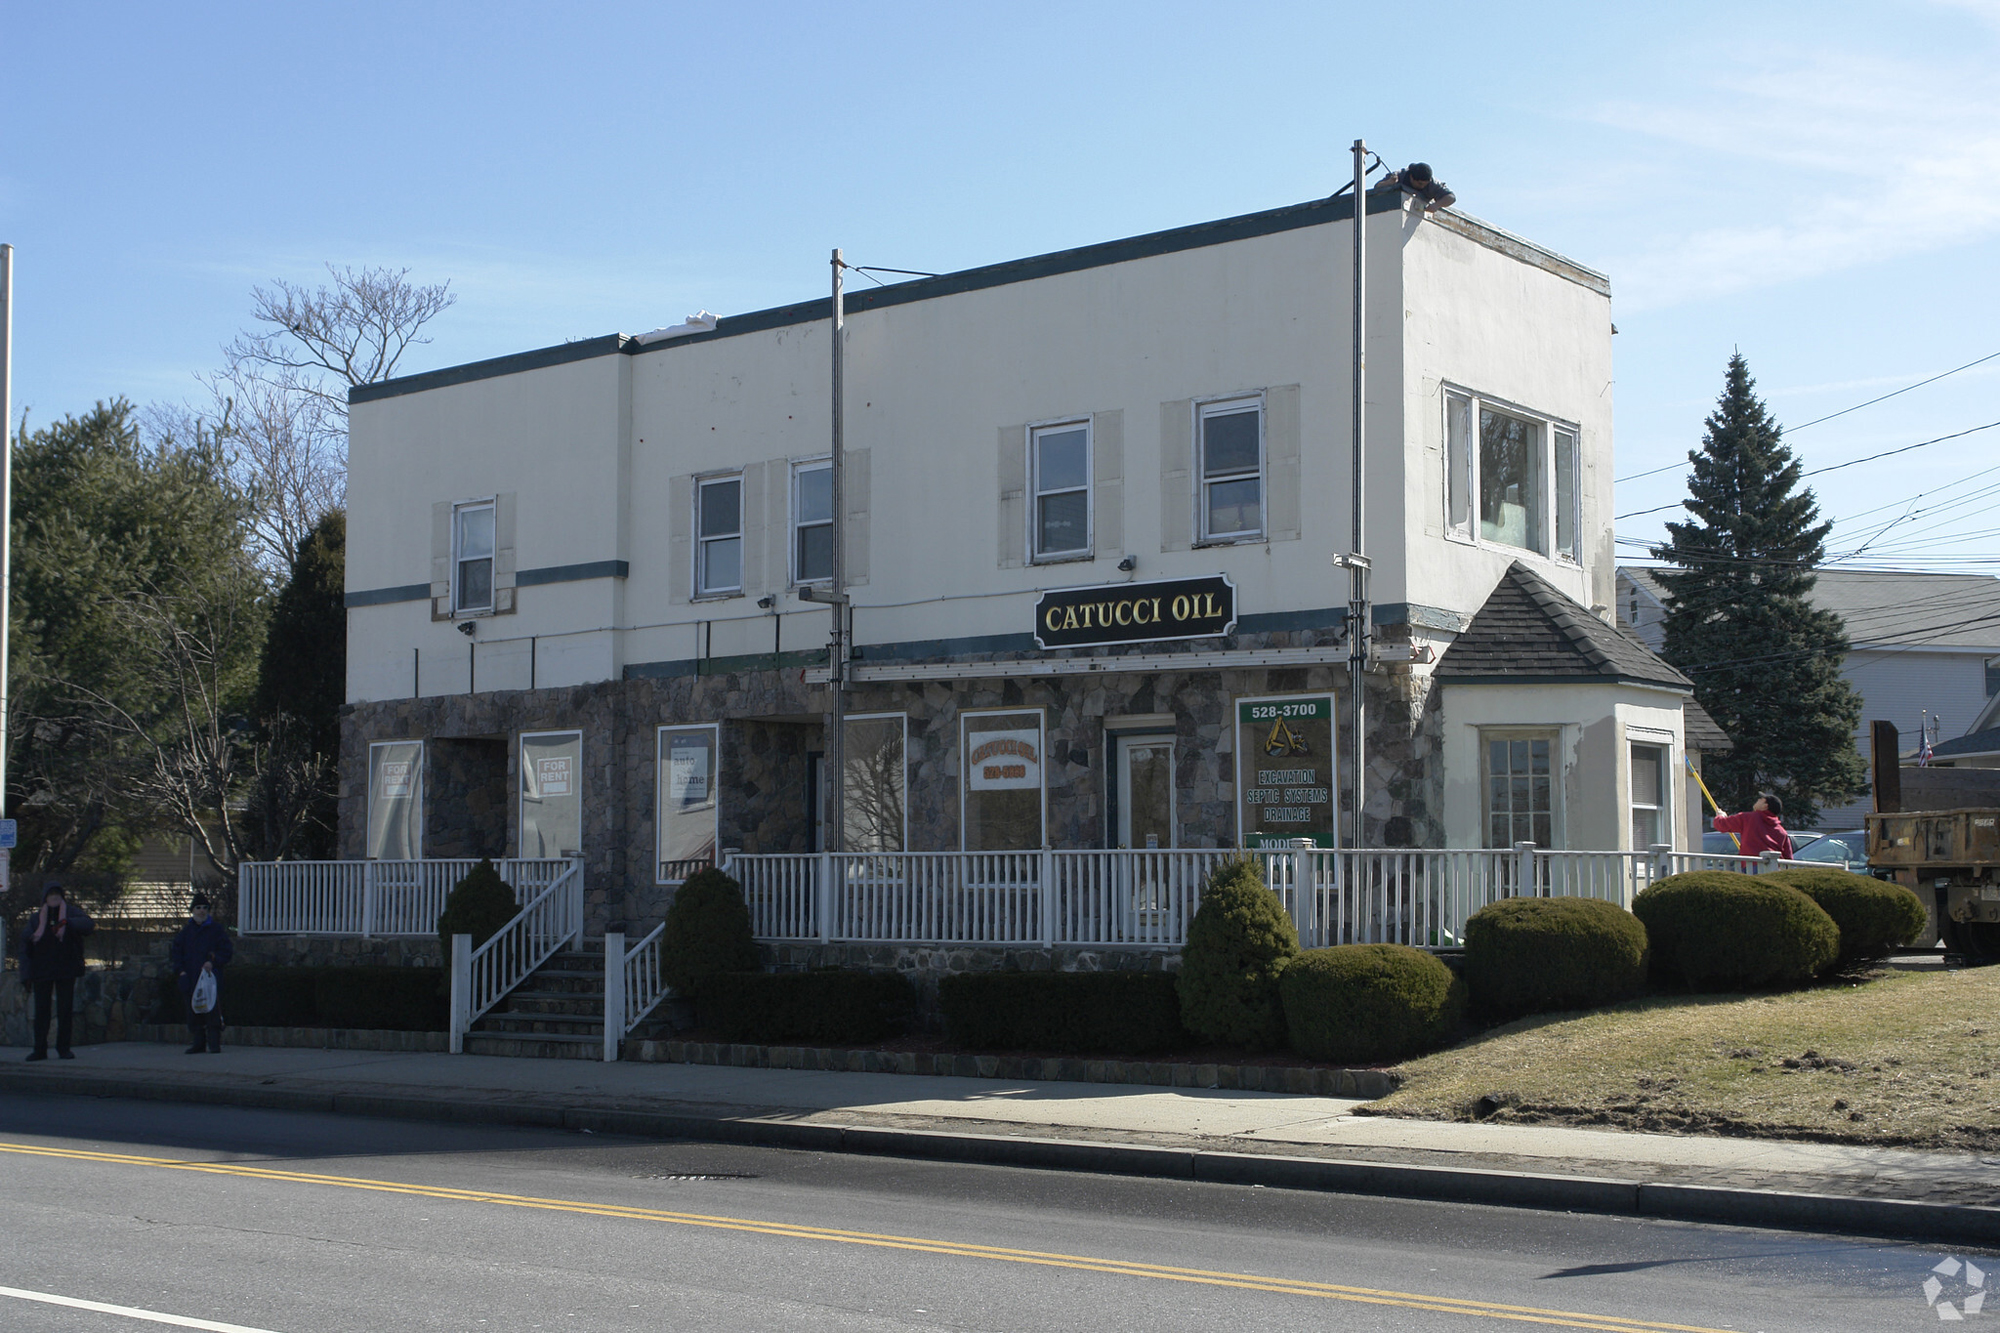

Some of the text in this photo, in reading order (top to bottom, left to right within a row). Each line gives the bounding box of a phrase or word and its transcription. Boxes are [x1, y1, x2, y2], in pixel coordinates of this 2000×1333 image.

[1046, 593, 1222, 631] CATUCCI OIL
[1252, 704, 1316, 718] 528-3700
[1018, 741, 1037, 764] OIL
[544, 761, 565, 771] FOR
[674, 756, 695, 766] auto
[388, 765, 407, 774] FOR
[385, 775, 410, 784] RENT
[541, 771, 569, 781] RENT
[677, 774, 704, 785] home
[1259, 769, 1315, 785] EXCAVATION
[1247, 788, 1328, 804] SEPTIC SYSTEMS
[1264, 807, 1311, 822] DRAINAGE
